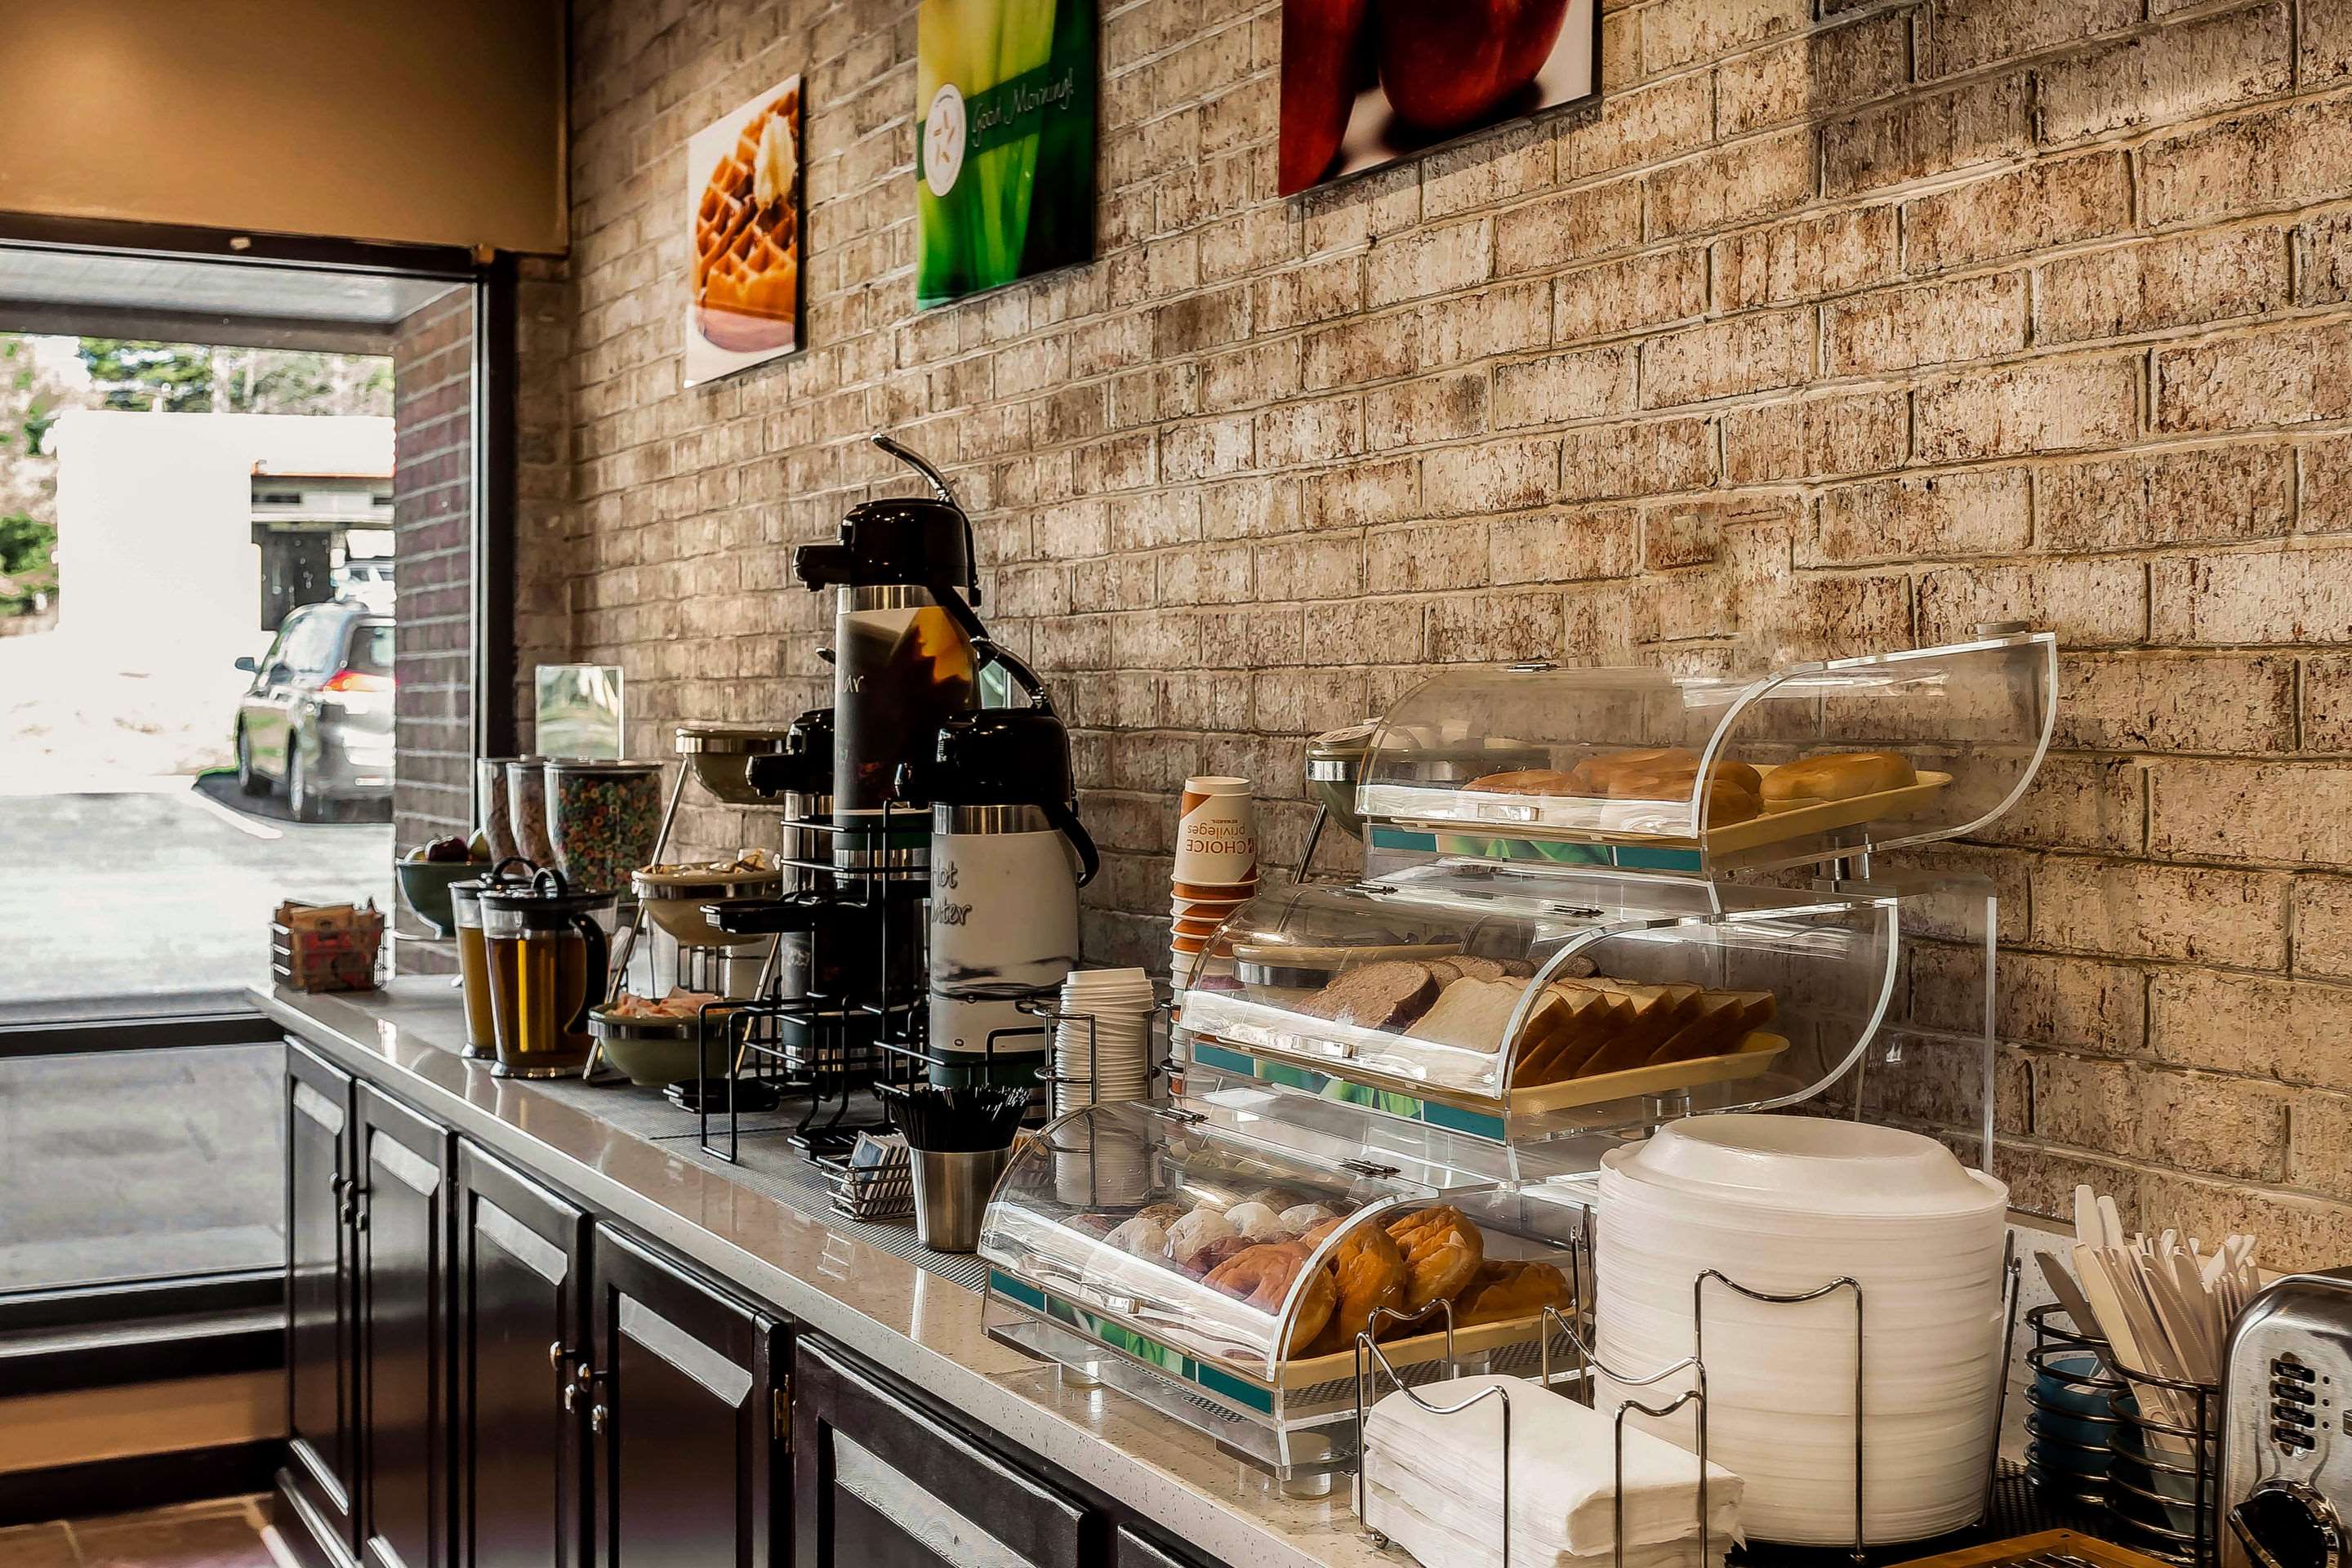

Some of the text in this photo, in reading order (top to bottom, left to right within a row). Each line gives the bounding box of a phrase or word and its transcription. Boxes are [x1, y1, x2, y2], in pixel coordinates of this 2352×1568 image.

[971, 67, 1074, 148] Good Morning!
[1187, 822, 1245, 840] privileges
[1185, 839, 1246, 855] CHOICE
